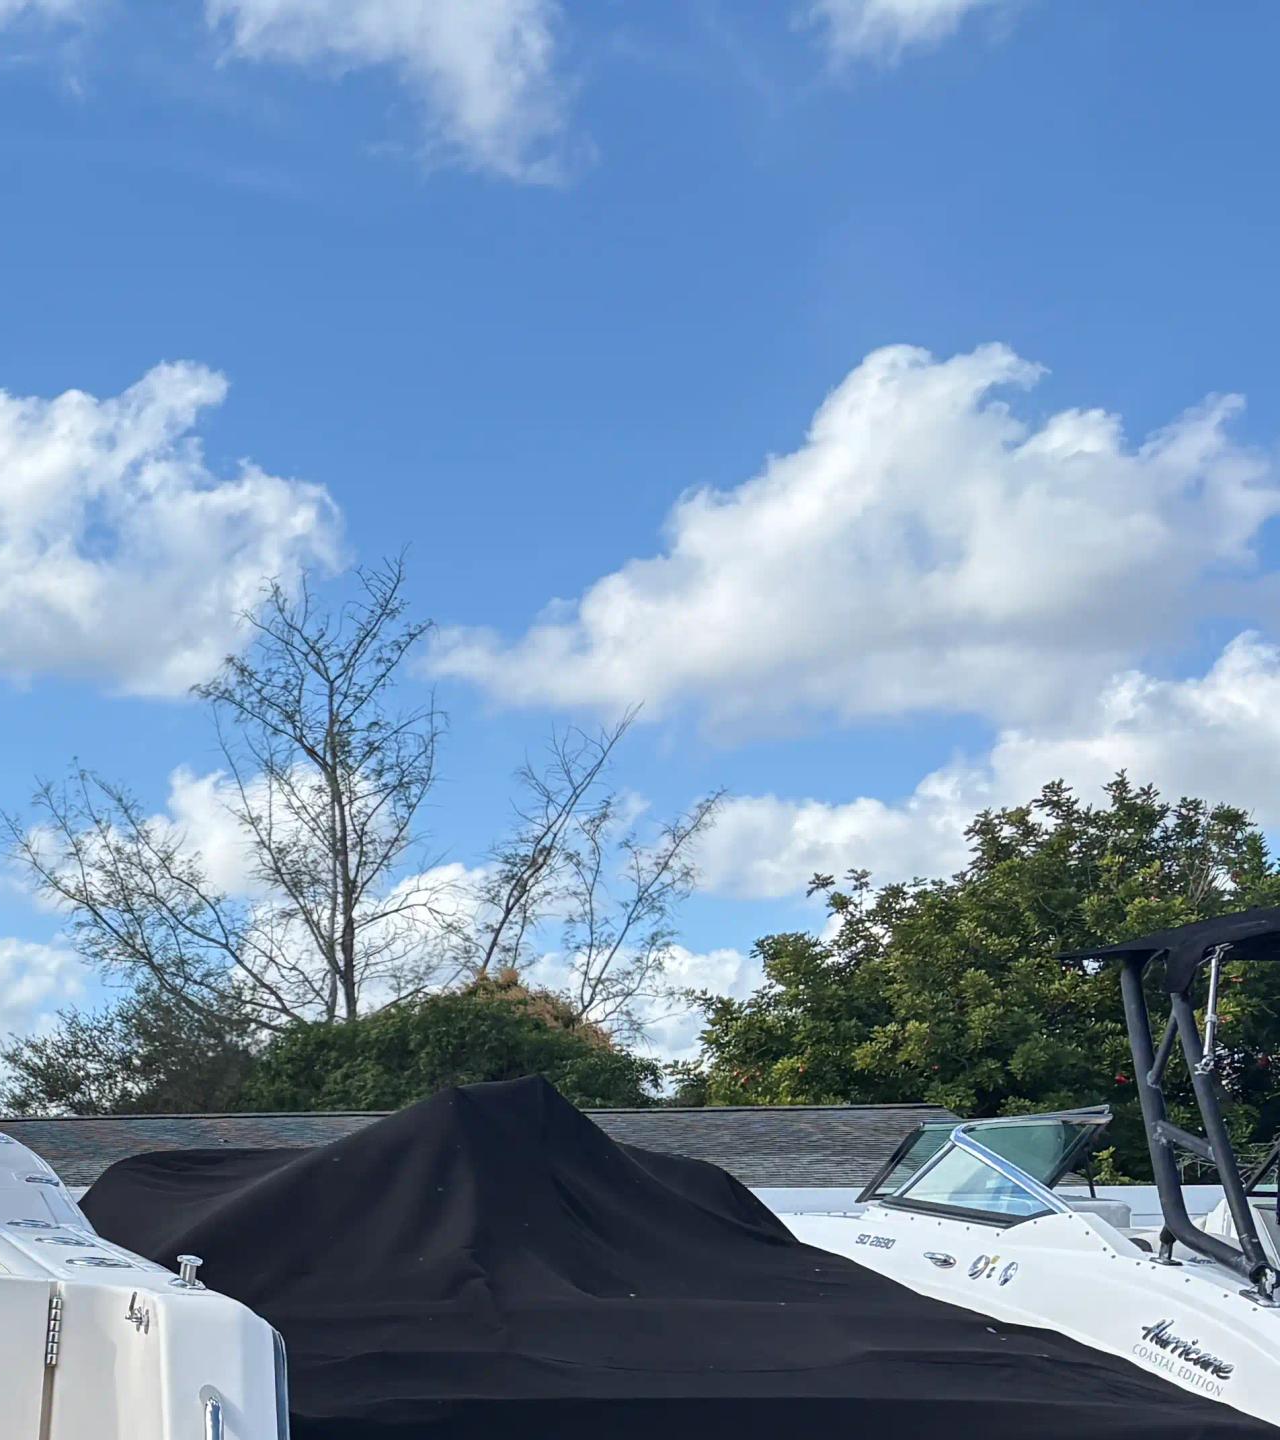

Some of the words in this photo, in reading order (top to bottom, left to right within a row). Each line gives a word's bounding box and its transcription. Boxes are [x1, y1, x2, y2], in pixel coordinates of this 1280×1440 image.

[1132, 1343, 1176, 1374] COASTAL
[1177, 1365, 1224, 1397] EDITION
[1141, 1319, 1234, 1380] Hurricane
